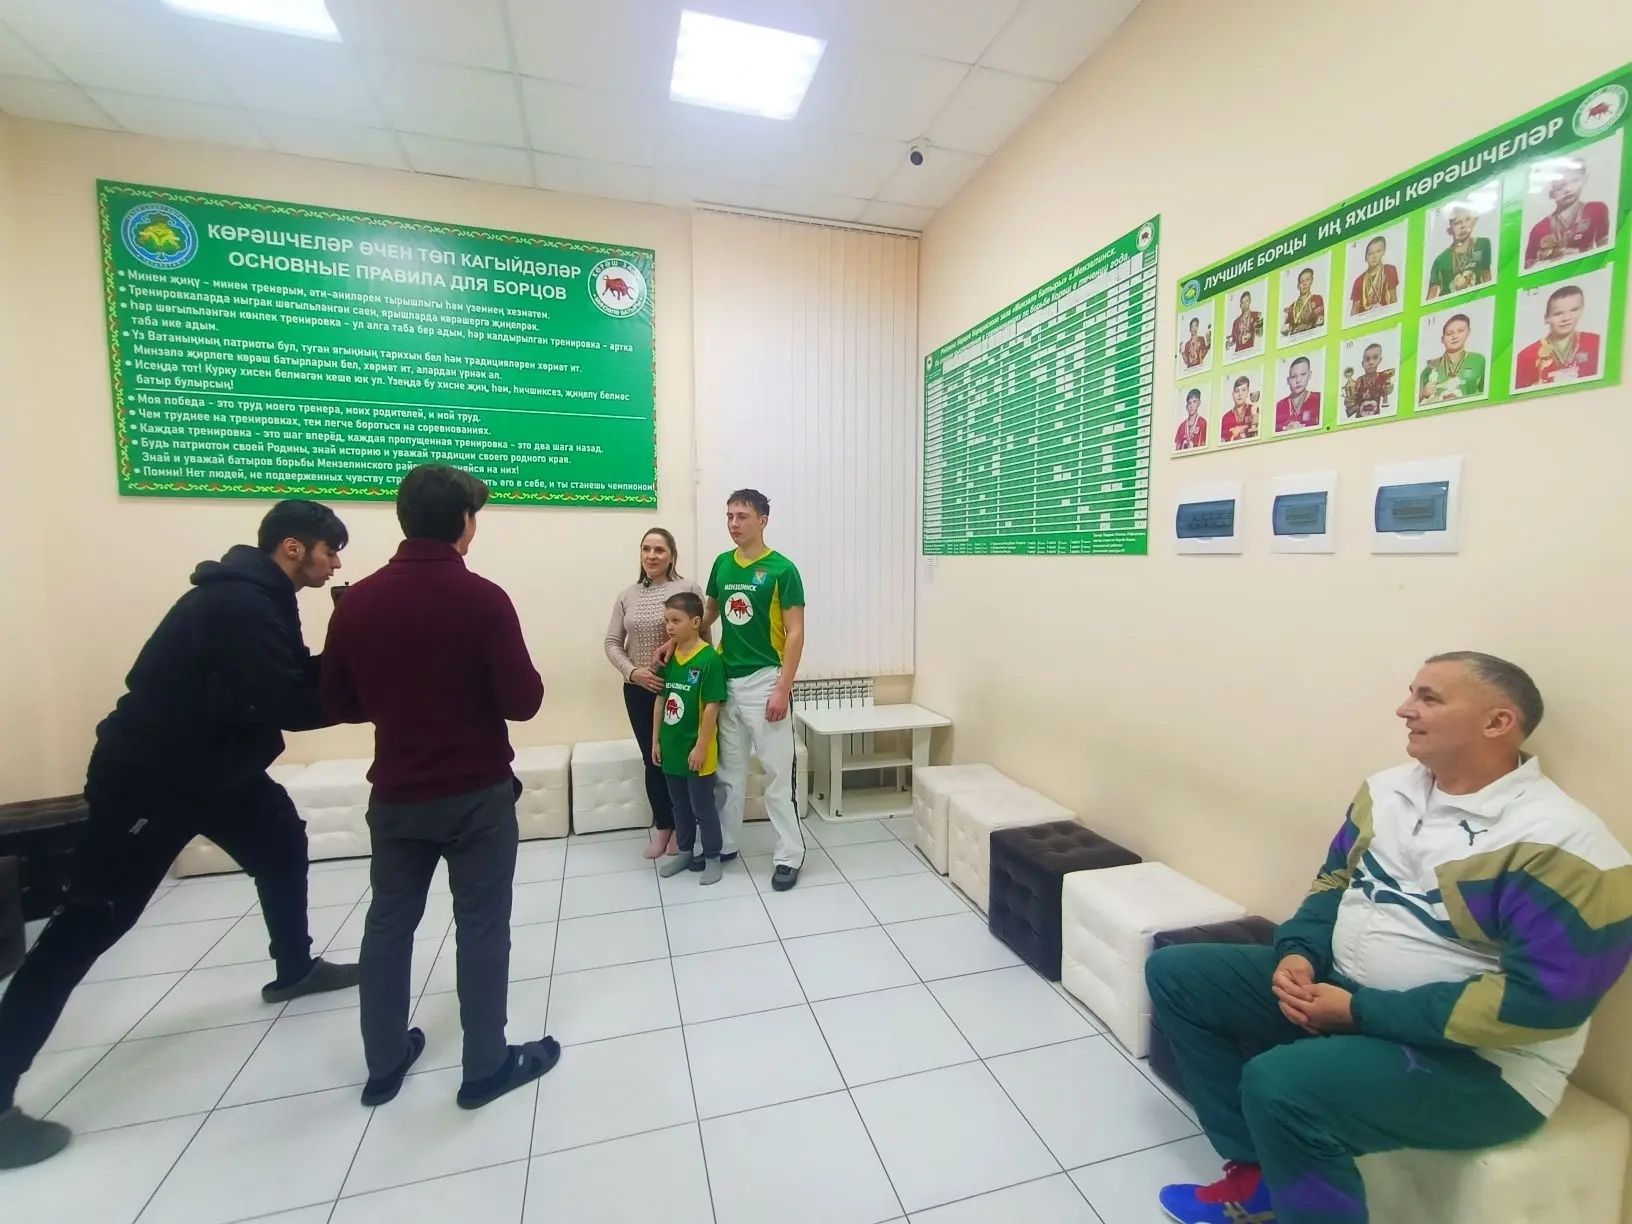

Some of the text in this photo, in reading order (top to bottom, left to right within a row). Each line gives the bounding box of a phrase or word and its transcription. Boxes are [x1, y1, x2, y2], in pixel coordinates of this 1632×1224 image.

[1203, 258, 1254, 291] ЛУЧШИЕ
[1257, 234, 1307, 267] БОРЦЫ
[1318, 218, 1341, 241] ИҢ
[1345, 191, 1400, 229] ЯХШЫ
[1406, 117, 1564, 201] КӨРӘШЧЕЛӘР
[207, 223, 581, 279] КӨРӘШЧЕЛӘР ӨЧЕН ТӨП КАГЫЙДӘЛӘР
[127, 268, 167, 282] Минем
[212, 279, 248, 290] минем
[250, 283, 306, 297] тренерым,
[383, 296, 443, 309] тырышлыгы
[228, 251, 566, 300] ОСНОВНЫЕ ПРАВИЛА ДЛЯ БОРЦОВ
[127, 284, 230, 304] Тренировкаларда
[233, 296, 273, 307] ныграк
[352, 307, 379, 317] саен,
[381, 309, 438, 322] ярышларда
[131, 315, 219, 331] таба ике адым.
[239, 311, 278, 321] көнлек
[280, 314, 341, 327] тренировка
[352, 320, 364, 330] ул
[366, 322, 389, 331] алга
[391, 323, 414, 334] таба
[417, 324, 434, 336] бер
[436, 328, 465, 339] адым,
[486, 332, 548, 344] калдырылган
[549, 338, 600, 349] тренировка
[609, 343, 633, 352] артка
[131, 329, 145, 339] Үз
[223, 338, 274, 349] патриоты
[277, 340, 298, 352] бул,
[301, 344, 329, 354] туган
[380, 350, 422, 360] тарихын
[424, 351, 441, 362] бел
[463, 356, 535, 370] традицияләрен
[570, 364, 582, 372] ит.
[186, 350, 234, 361] җирлеге
[273, 354, 337, 368] батырларын
[340, 359, 361, 370] бел,
[400, 365, 413, 374] ит,
[416, 366, 456, 376] алардан
[488, 371, 502, 379] ал.
[136, 373, 171, 387] батыр
[181, 363, 202, 373] тот!
[205, 363, 237, 377] Курку
[239, 368, 271, 377] хисен
[325, 373, 351, 382] кеше
[354, 375, 369, 384] юк
[370, 376, 385, 386] ул.
[423, 378, 435, 390] бу
[437, 381, 465, 390] хисне
[599, 390, 629, 400] белмәс
[137, 393, 481, 423] Моя победа это труд моего тренера, моих родителей, мой труд.
[138, 408, 491, 435] Чем труднее на тренировках, тем легче бороться на соревнованиях.
[139, 422, 184, 435] Каждая
[187, 427, 252, 438] тренировка
[263, 430, 280, 438] это
[283, 431, 303, 439] шаг
[305, 431, 345, 442] вперёд,
[347, 434, 385, 444] каждая
[388, 436, 452, 446] пропущенная
[454, 439, 508, 449] тренировка
[533, 442, 550, 451] два
[552, 443, 573, 451] шага
[575, 444, 603, 454] назад.
[140, 437, 571, 465] Будь патриотом своей Родины, знай историю уважай традиции своего родного края.
[142, 451, 170, 462] Знай
[183, 454, 224, 465] уважай
[227, 455, 273, 467] батыров
[275, 456, 314, 468] борьбы
[317, 458, 393, 469] Мензелинского
[500, 465, 519, 474] них!
[143, 466, 183, 477] Помни!
[185, 467, 205, 477] Нет
[208, 468, 247, 479] людей,
[249, 471, 262, 479] не
[265, 472, 343, 482] подверженных
[345, 474, 383, 484] чувству
[499, 479, 514, 487] его
[524, 478, 547, 488] себе,
[570, 481, 605, 489] станешь
